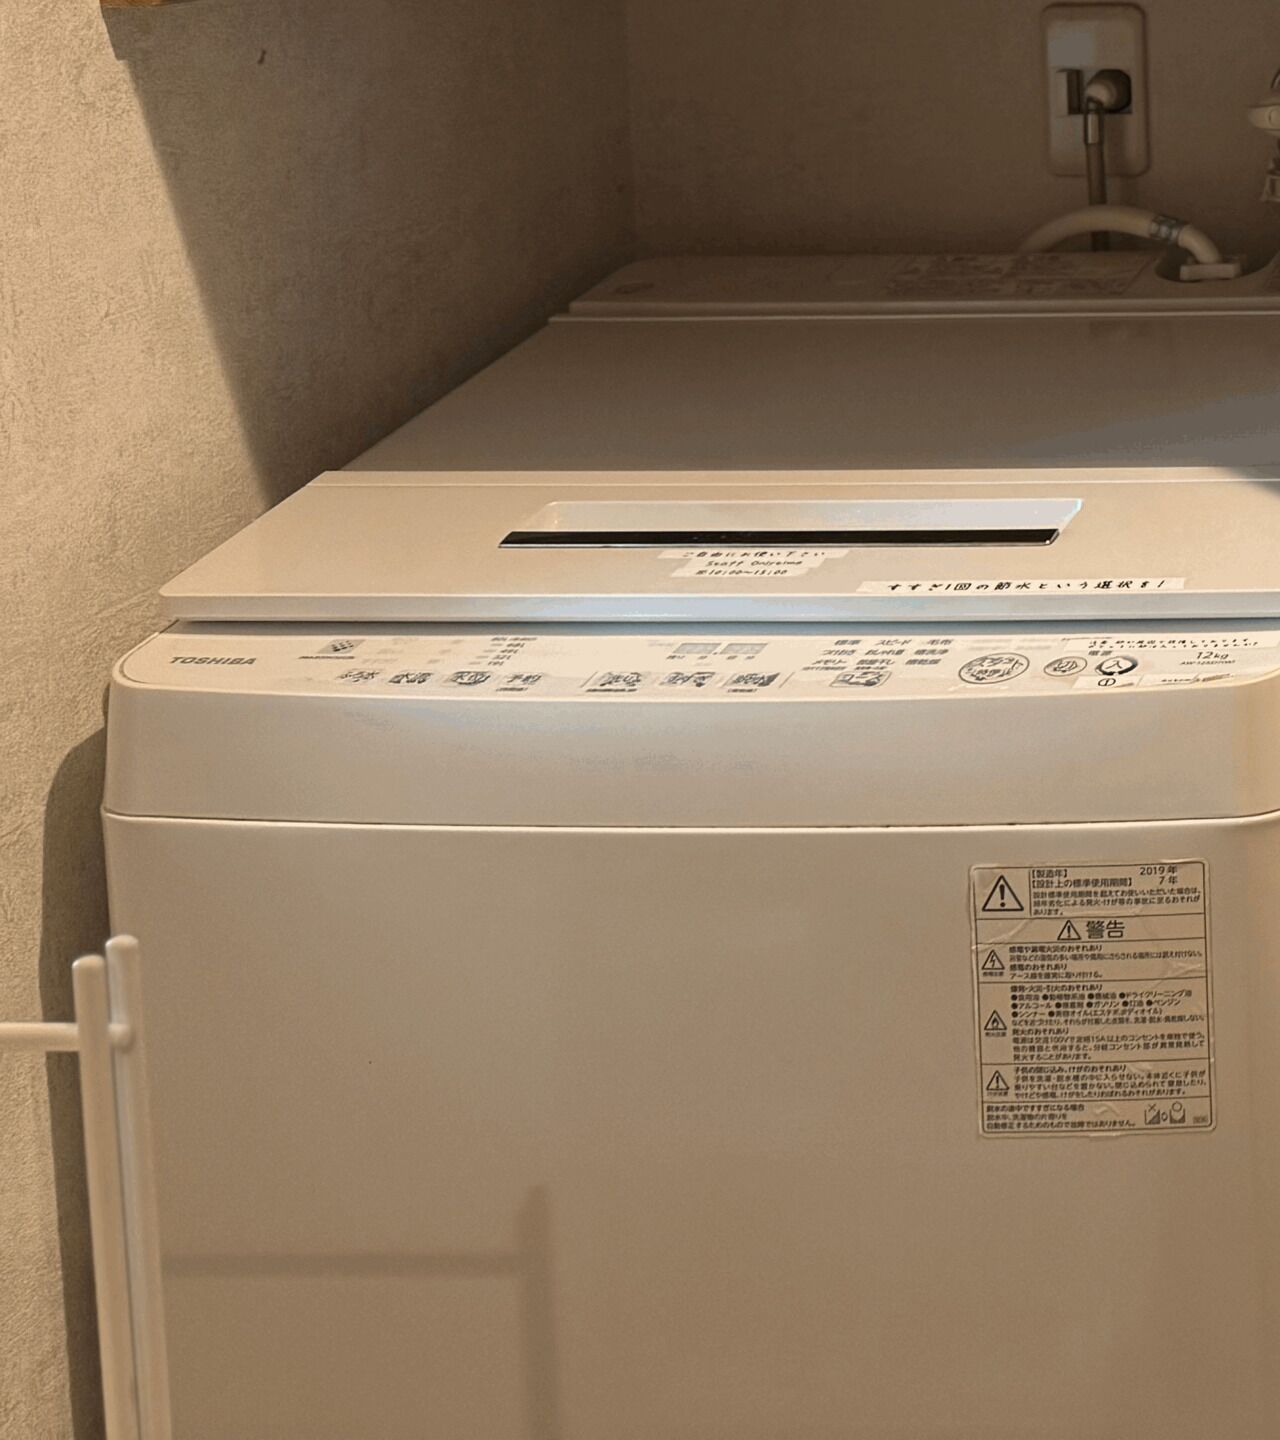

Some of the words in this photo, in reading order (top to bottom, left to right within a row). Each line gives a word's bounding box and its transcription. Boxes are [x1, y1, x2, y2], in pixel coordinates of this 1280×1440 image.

[169, 656, 257, 665] TOSHIBA
[1196, 651, 1229, 661] 12kg
[1140, 866, 1165, 876] 2019
[1168, 865, 1177, 874] 年
[1159, 876, 1164, 885] 7
[1168, 875, 1177, 884] 年
[1086, 919, 1125, 939] 警告
